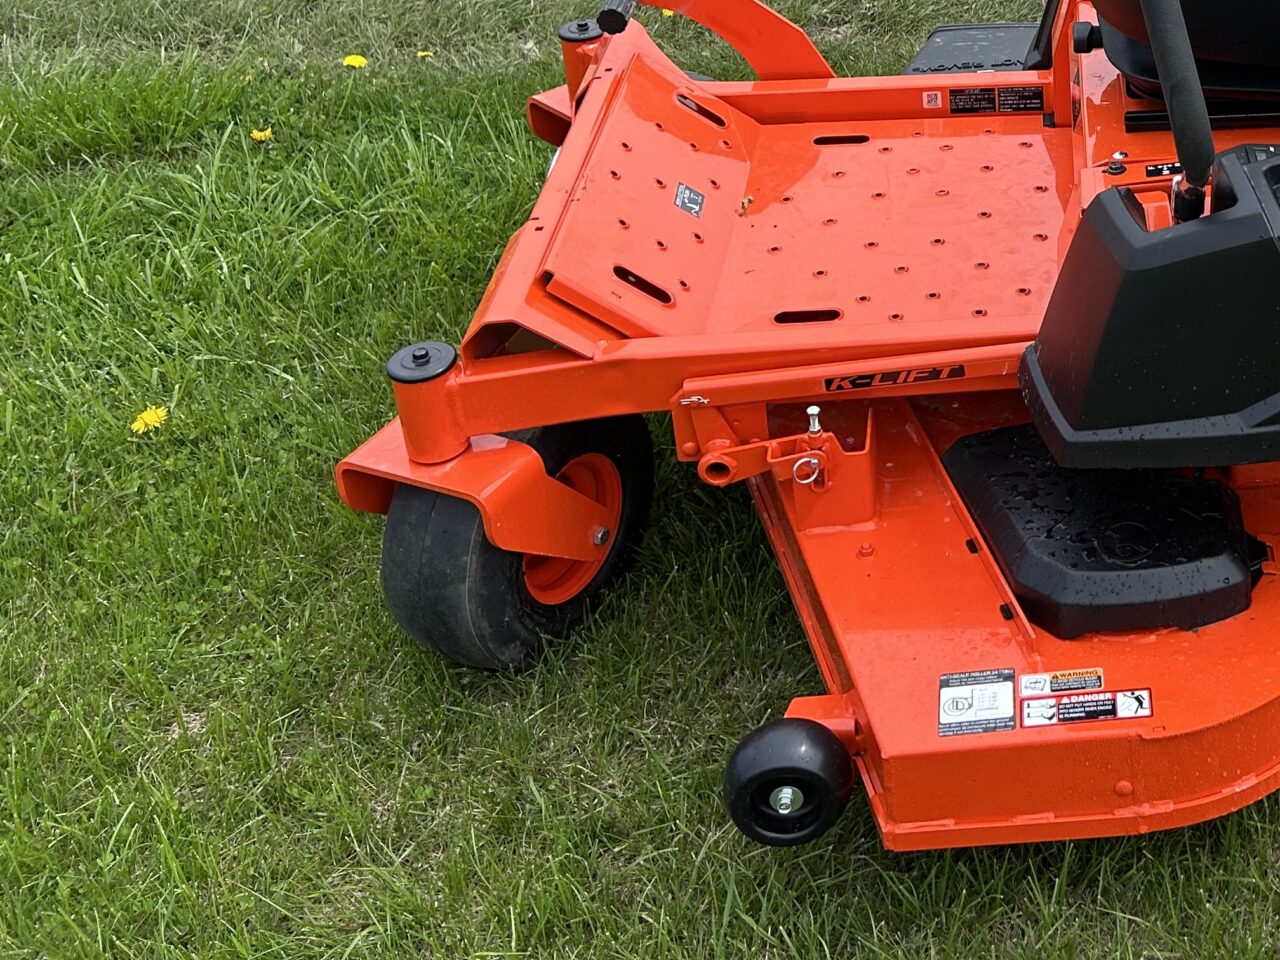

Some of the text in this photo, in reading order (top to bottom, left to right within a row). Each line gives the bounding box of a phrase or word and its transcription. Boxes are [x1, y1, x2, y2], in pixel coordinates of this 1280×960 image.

[829, 365, 961, 391] K-LIFT
[1059, 669, 1098, 678] WARNING
[1070, 692, 1112, 703] DANGER
